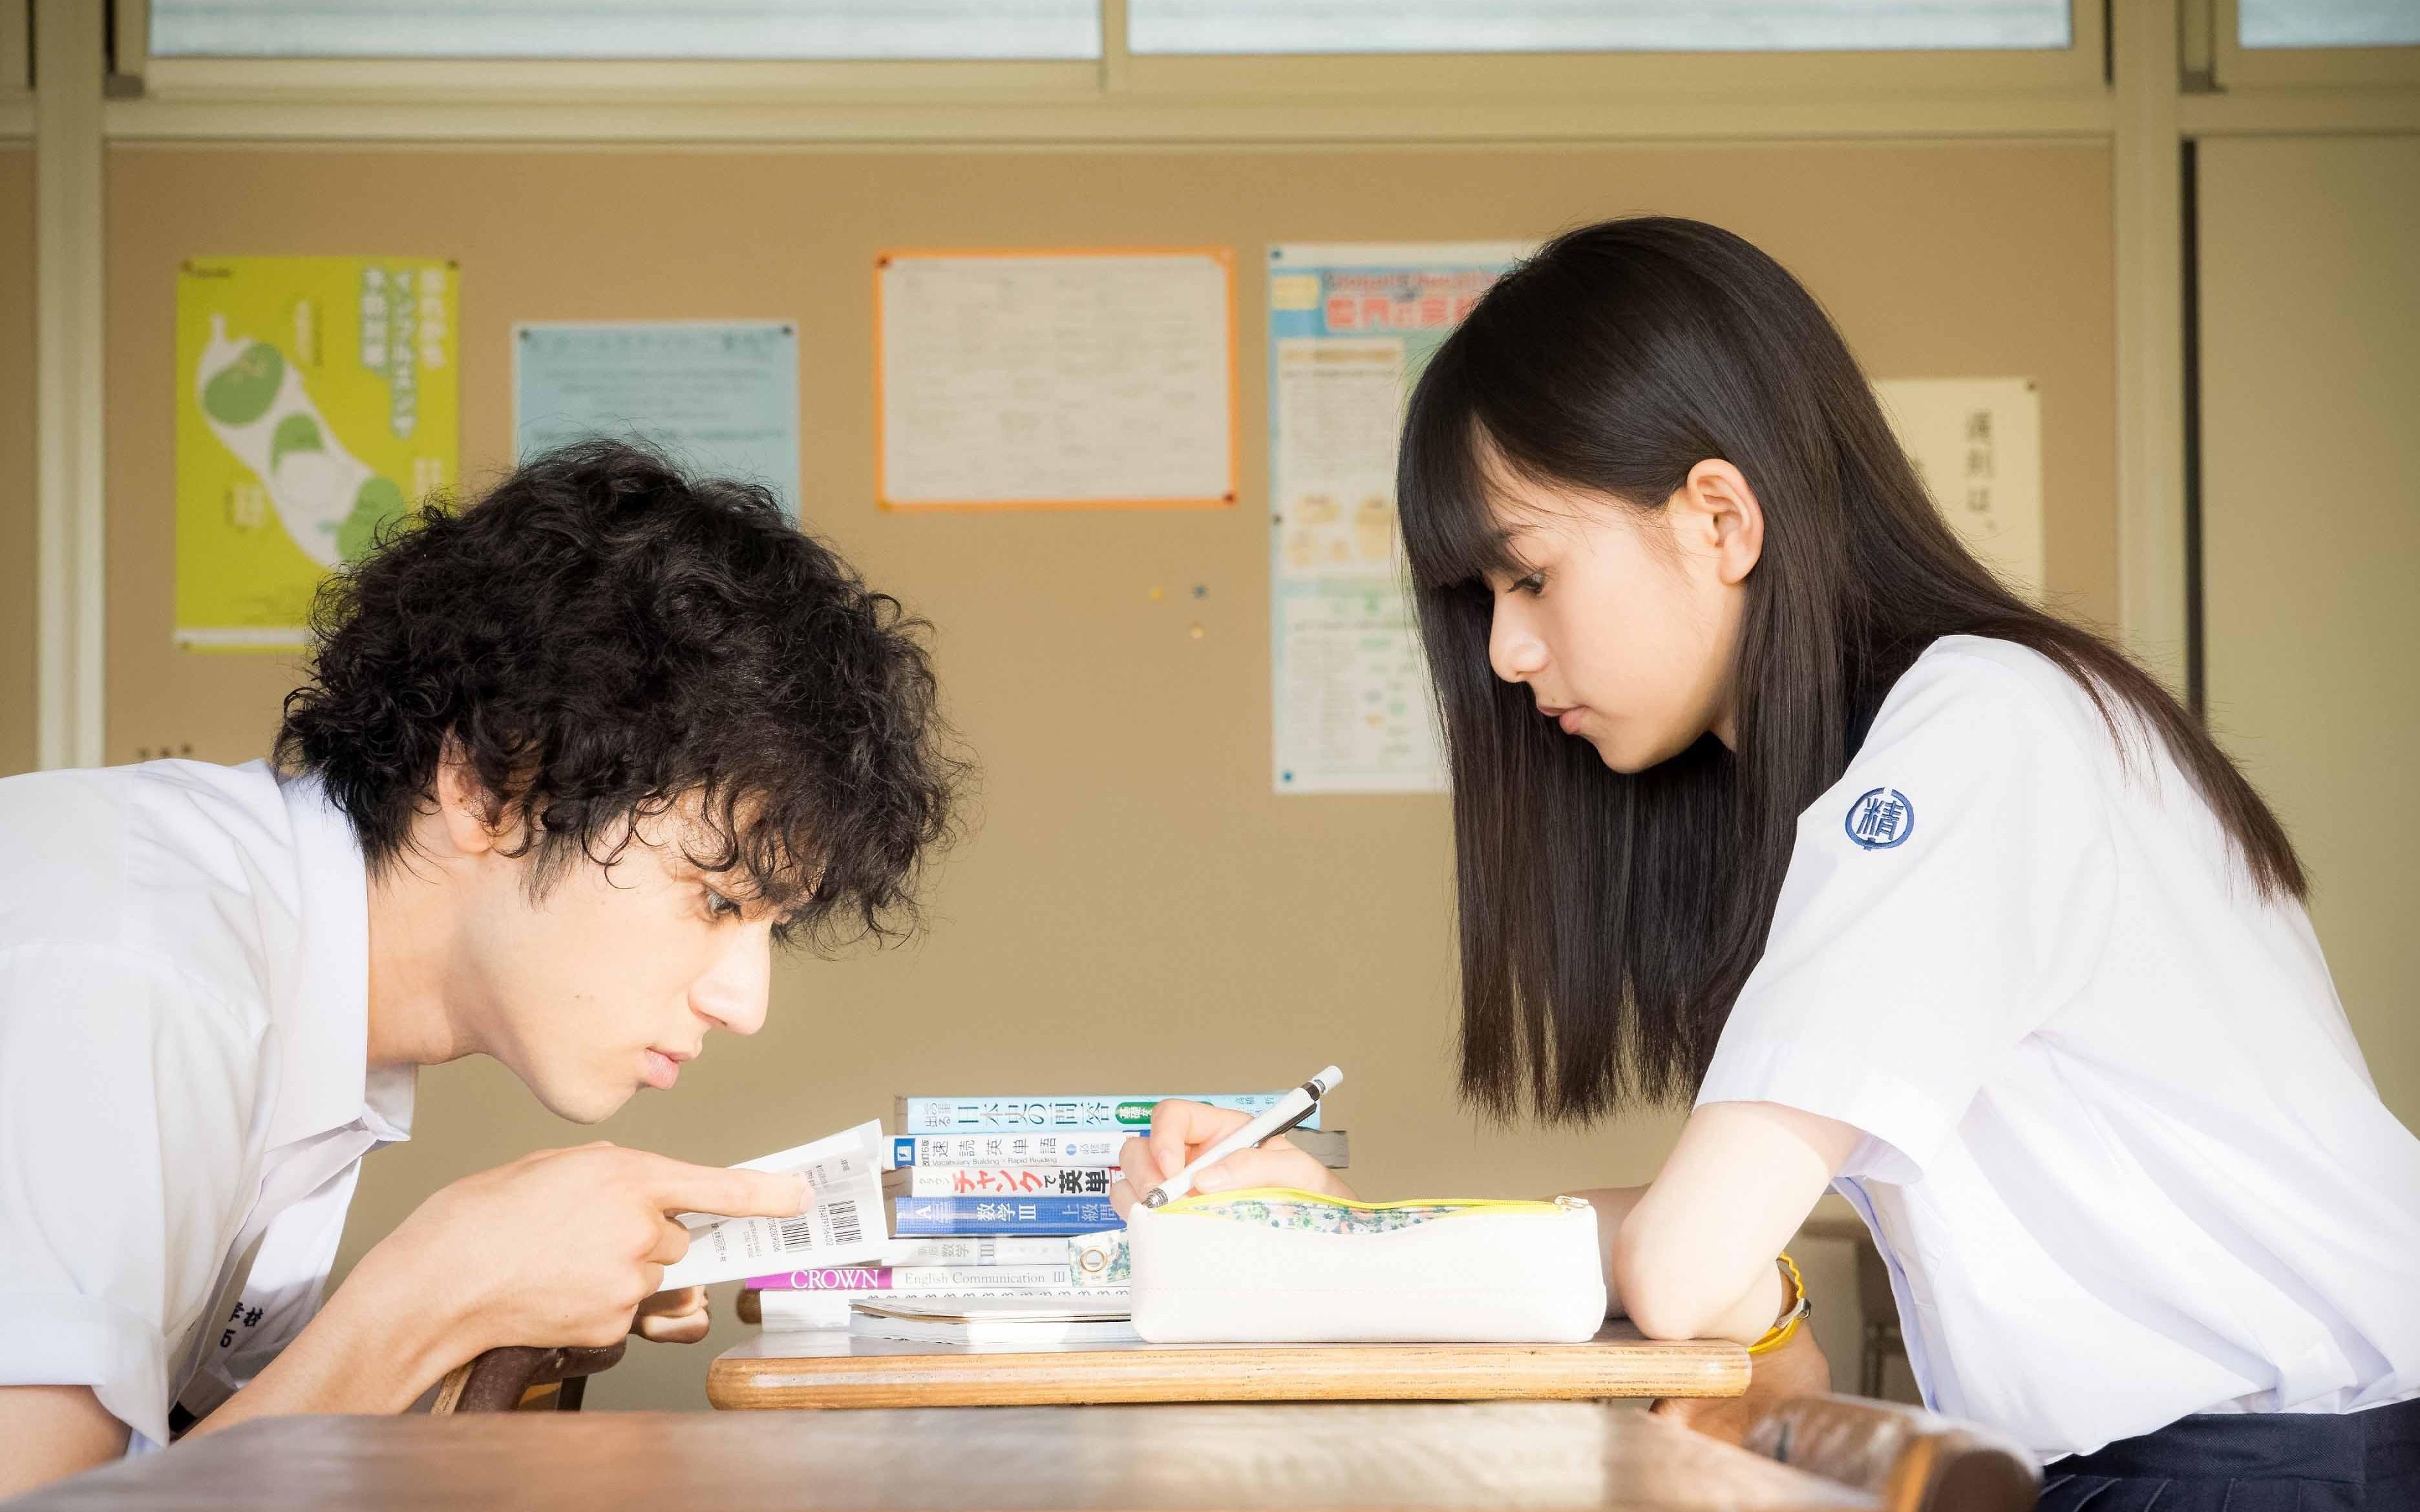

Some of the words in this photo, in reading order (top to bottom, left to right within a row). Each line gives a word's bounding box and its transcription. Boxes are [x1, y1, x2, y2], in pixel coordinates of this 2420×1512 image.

[1856, 797, 1904, 841] 精
[958, 1102, 1109, 1126] 日本史の一問一答
[932, 1138, 1057, 1158] 速読英単語
[932, 1159, 970, 1168] Vocabulary
[972, 1157, 999, 1166] Building
[1008, 1157, 1028, 1166] Rapid
[952, 1169, 1110, 1194] チャンクで英単
[791, 1268, 880, 1289] CROWN
[904, 1271, 949, 1285] English
[952, 1271, 1045, 1284] Communication
